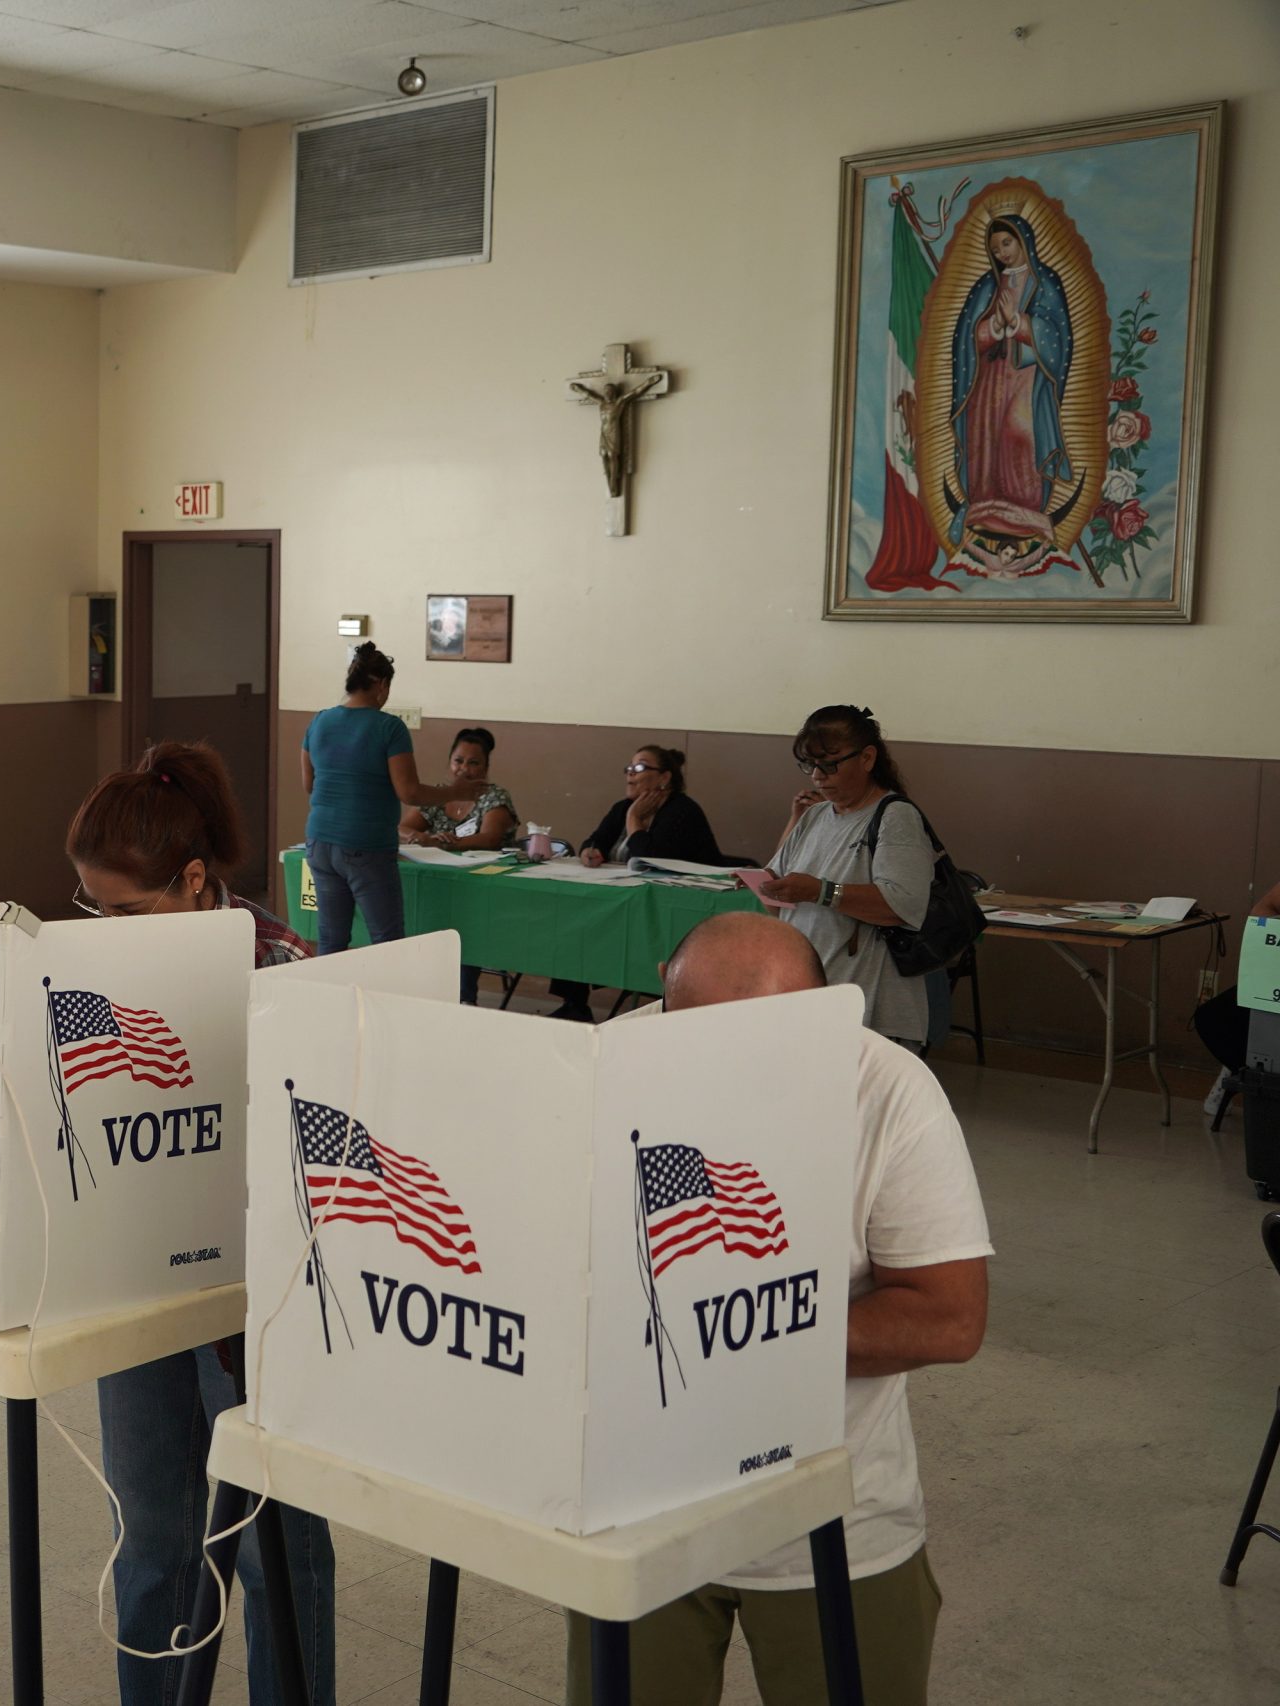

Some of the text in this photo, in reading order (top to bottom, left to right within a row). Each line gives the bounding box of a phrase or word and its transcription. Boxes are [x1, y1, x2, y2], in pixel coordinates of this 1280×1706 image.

[182, 486, 210, 515] EXIT
[1265, 934, 1280, 947] B
[102, 1103, 222, 1166] VOTE
[360, 1270, 525, 1376] VOTE
[693, 1269, 818, 1360] VOTE
